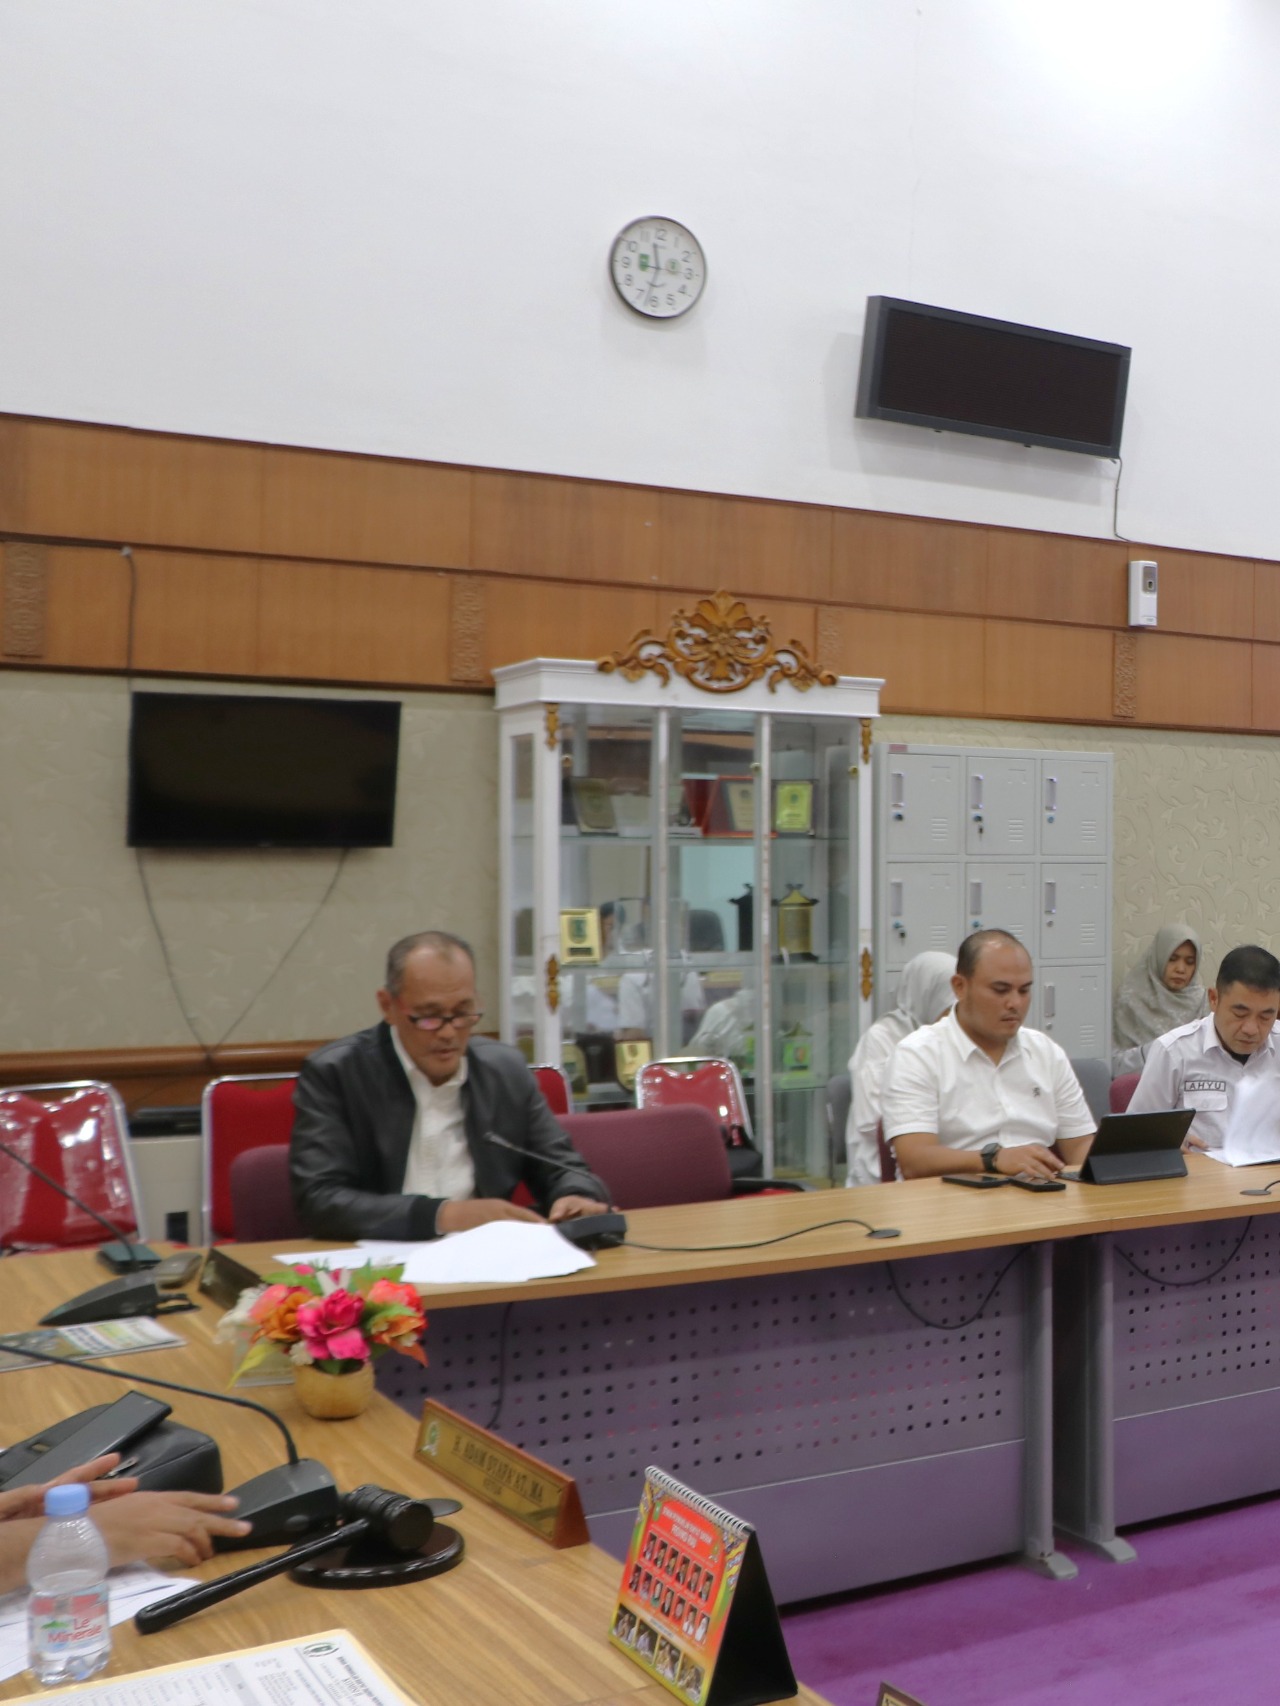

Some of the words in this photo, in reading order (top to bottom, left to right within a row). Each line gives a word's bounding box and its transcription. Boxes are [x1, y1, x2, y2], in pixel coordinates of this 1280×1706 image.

[655, 228, 667, 241] 12
[621, 256, 630, 269] 9
[681, 250, 690, 263] 2
[684, 267, 693, 280] 3
[624, 274, 633, 287] 8
[636, 287, 645, 300] 7
[666, 293, 675, 306] 5
[649, 295, 658, 308] 6
[1189, 1082, 1221, 1090] AHYU
[73, 1618, 90, 1631] Le
[47, 1624, 104, 1643] Minerale
